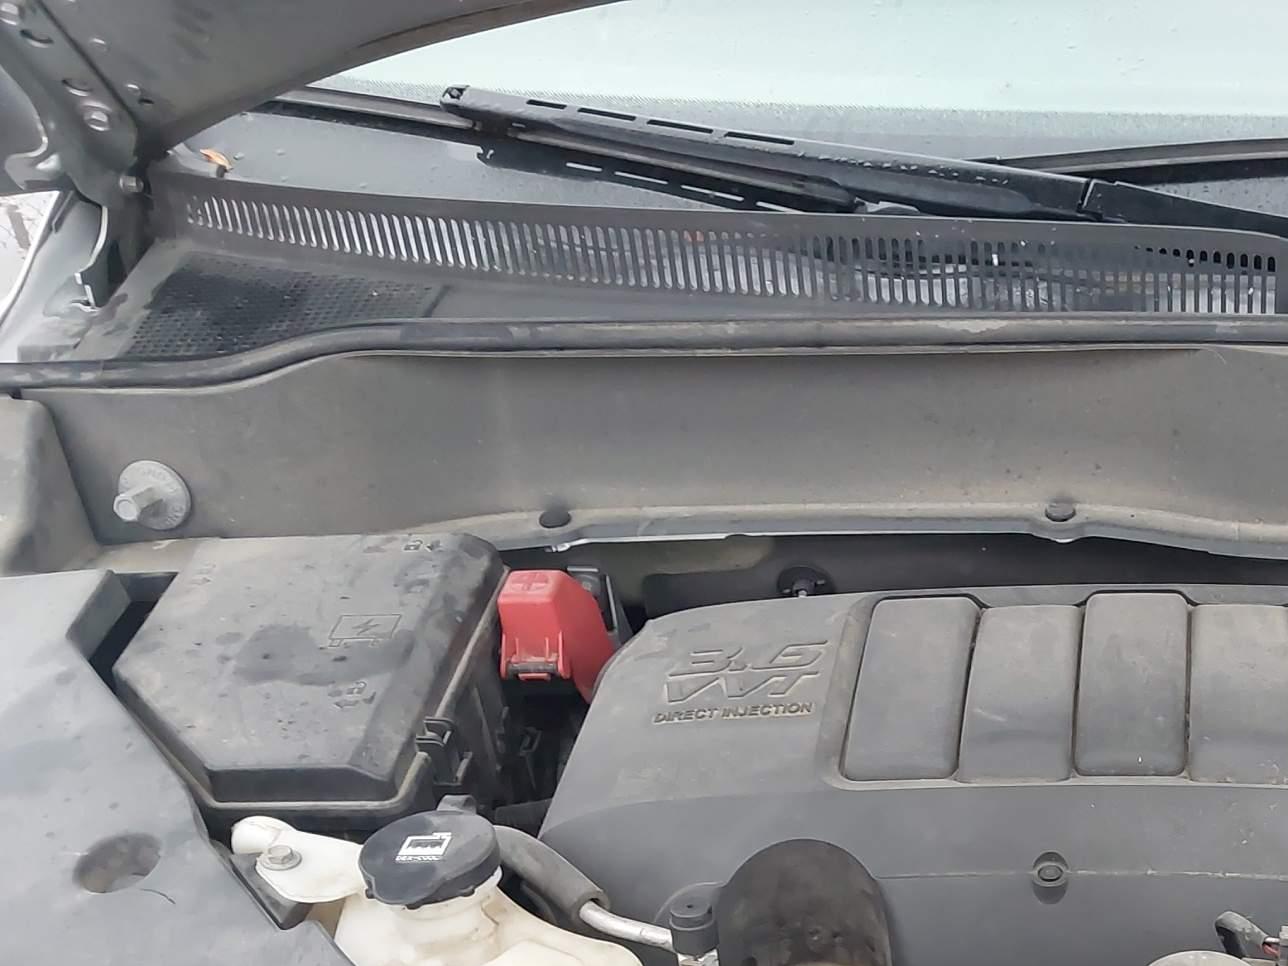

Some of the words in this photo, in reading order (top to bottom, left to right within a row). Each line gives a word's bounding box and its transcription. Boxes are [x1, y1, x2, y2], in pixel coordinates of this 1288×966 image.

[666, 640, 829, 677] 3.6
[665, 671, 821, 704] VVT
[653, 707, 719, 724] DIRECT
[721, 701, 813, 719] INJECTION
